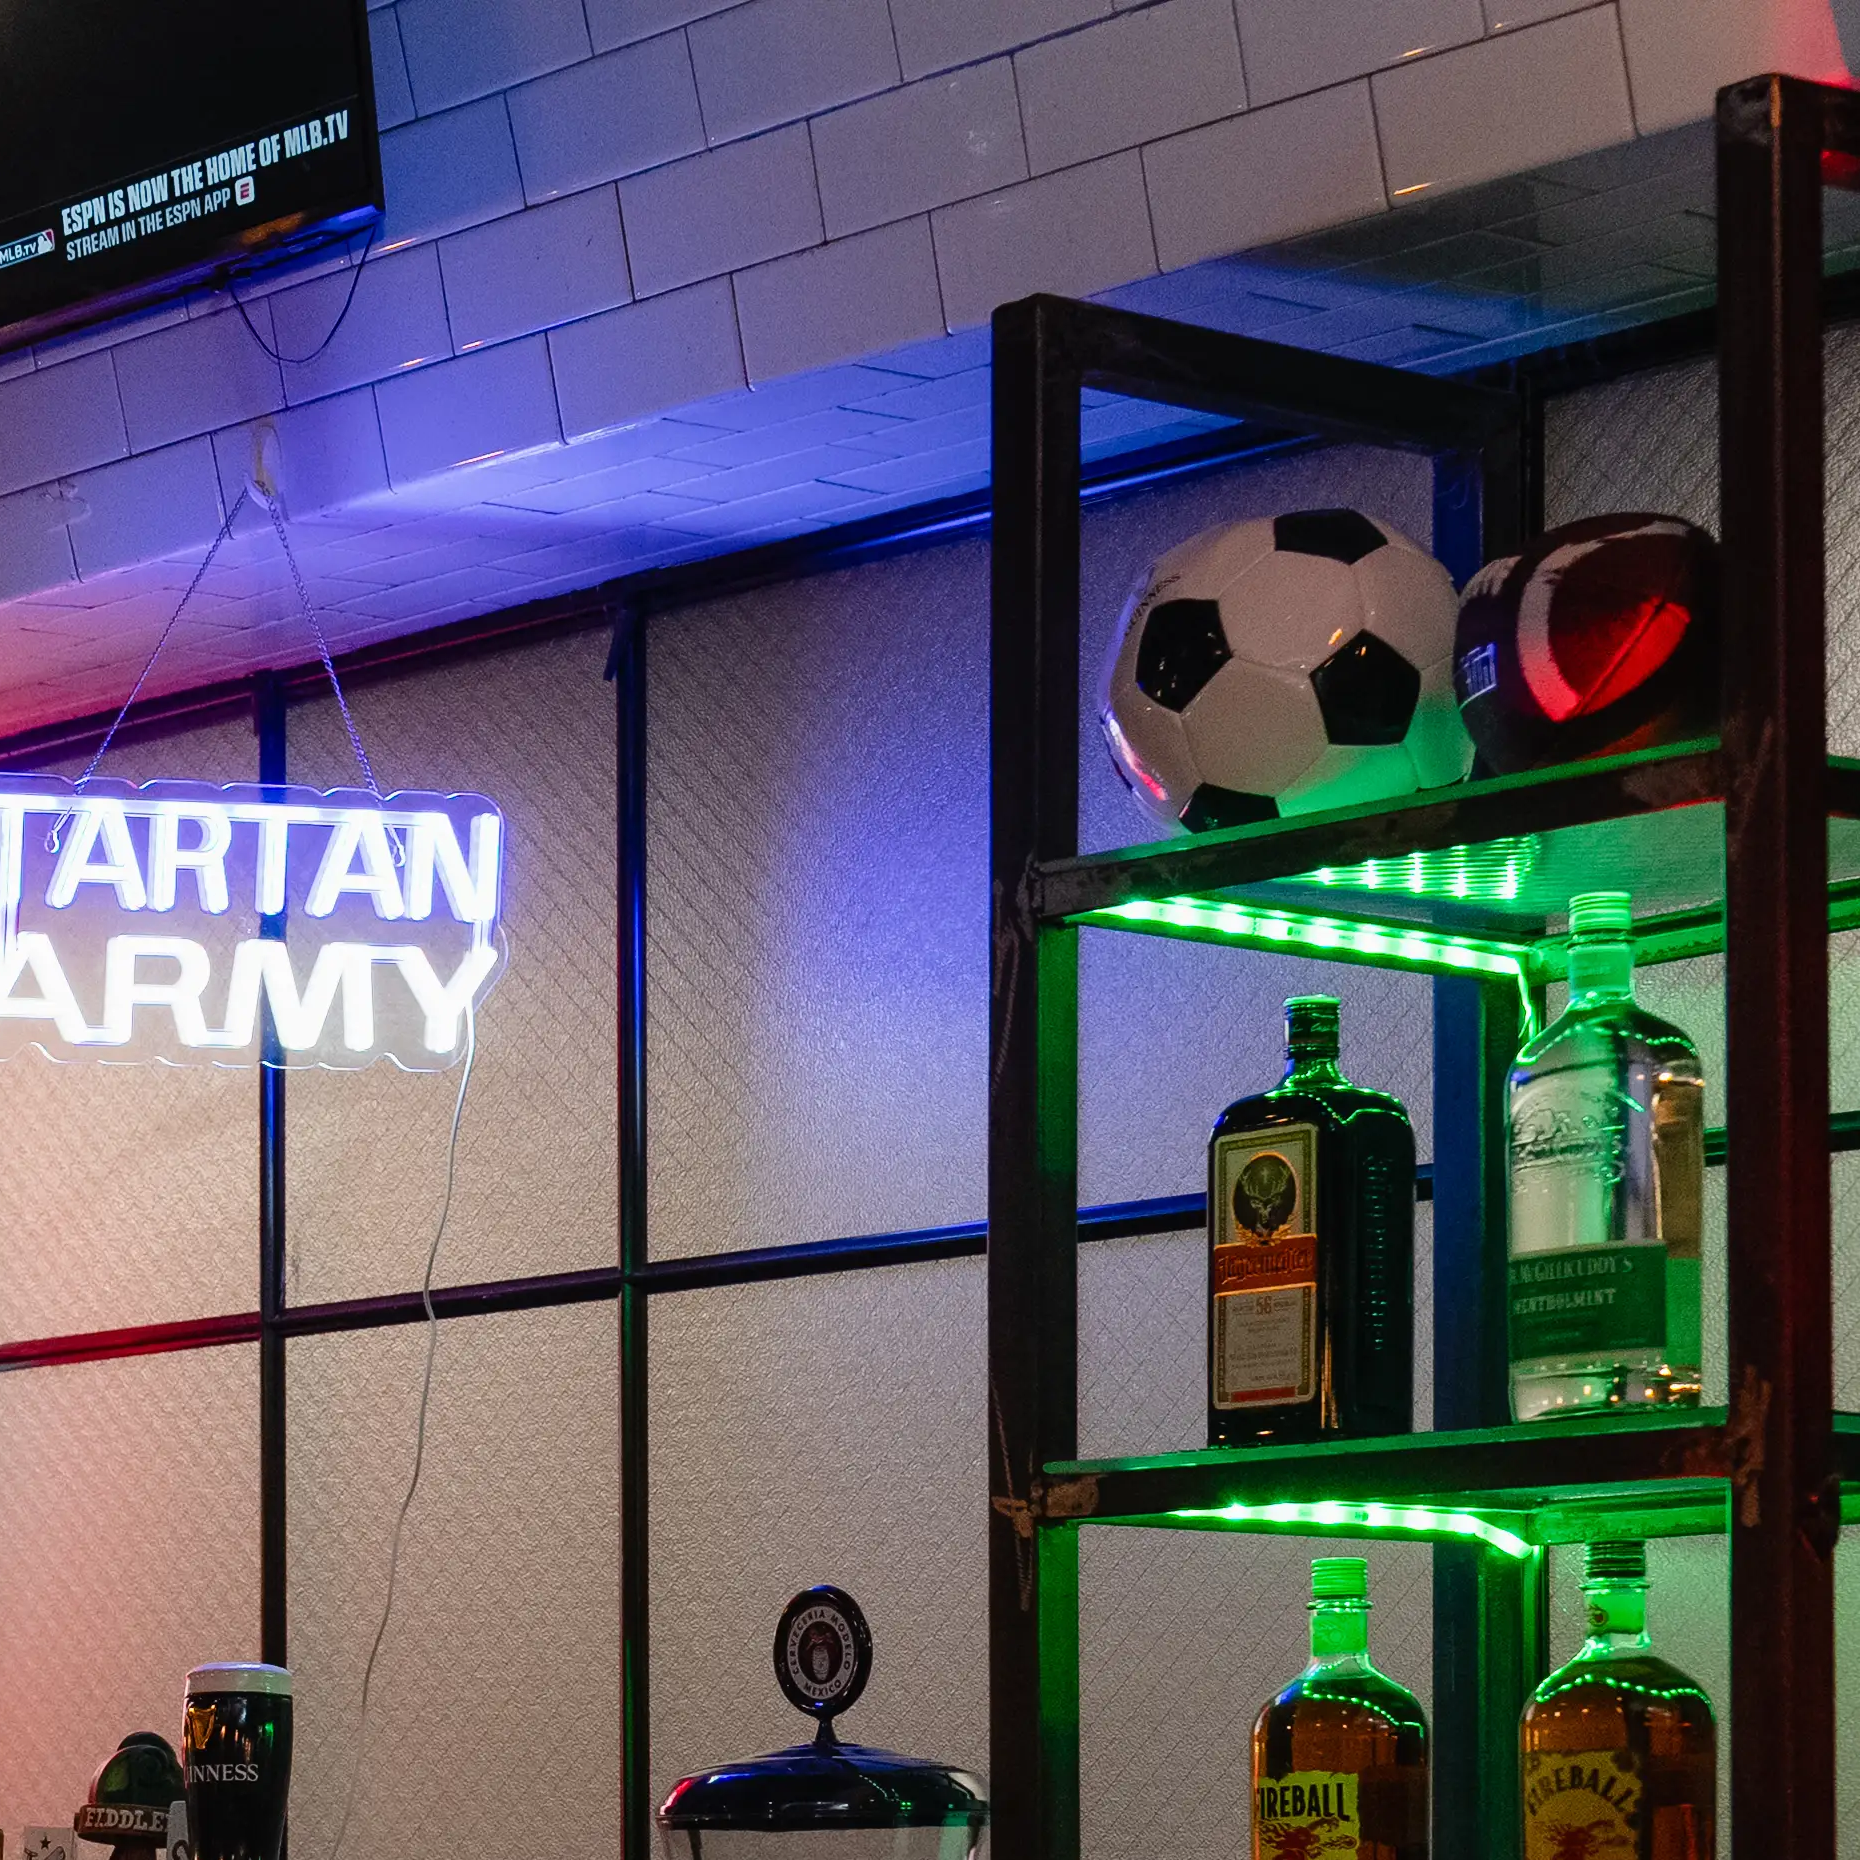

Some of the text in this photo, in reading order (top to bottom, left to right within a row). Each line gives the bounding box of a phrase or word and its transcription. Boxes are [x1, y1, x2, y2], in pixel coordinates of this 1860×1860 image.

[62, 109, 349, 236] ESPN IS NOW THE HOME OF MLB.TV
[66, 224, 120, 261] STREAM
[122, 219, 138, 245] IN
[139, 209, 164, 240] THE
[166, 197, 202, 231] ESPN
[204, 186, 232, 219] APP
[789, 1609, 853, 1676] CERVECERIA MODELO
[804, 1678, 843, 1698] MEXICO
[188, 1762, 260, 1783] INNESS
[1528, 1765, 1634, 1817] FIREBALL
[84, 1806, 170, 1833] FIDDLE
